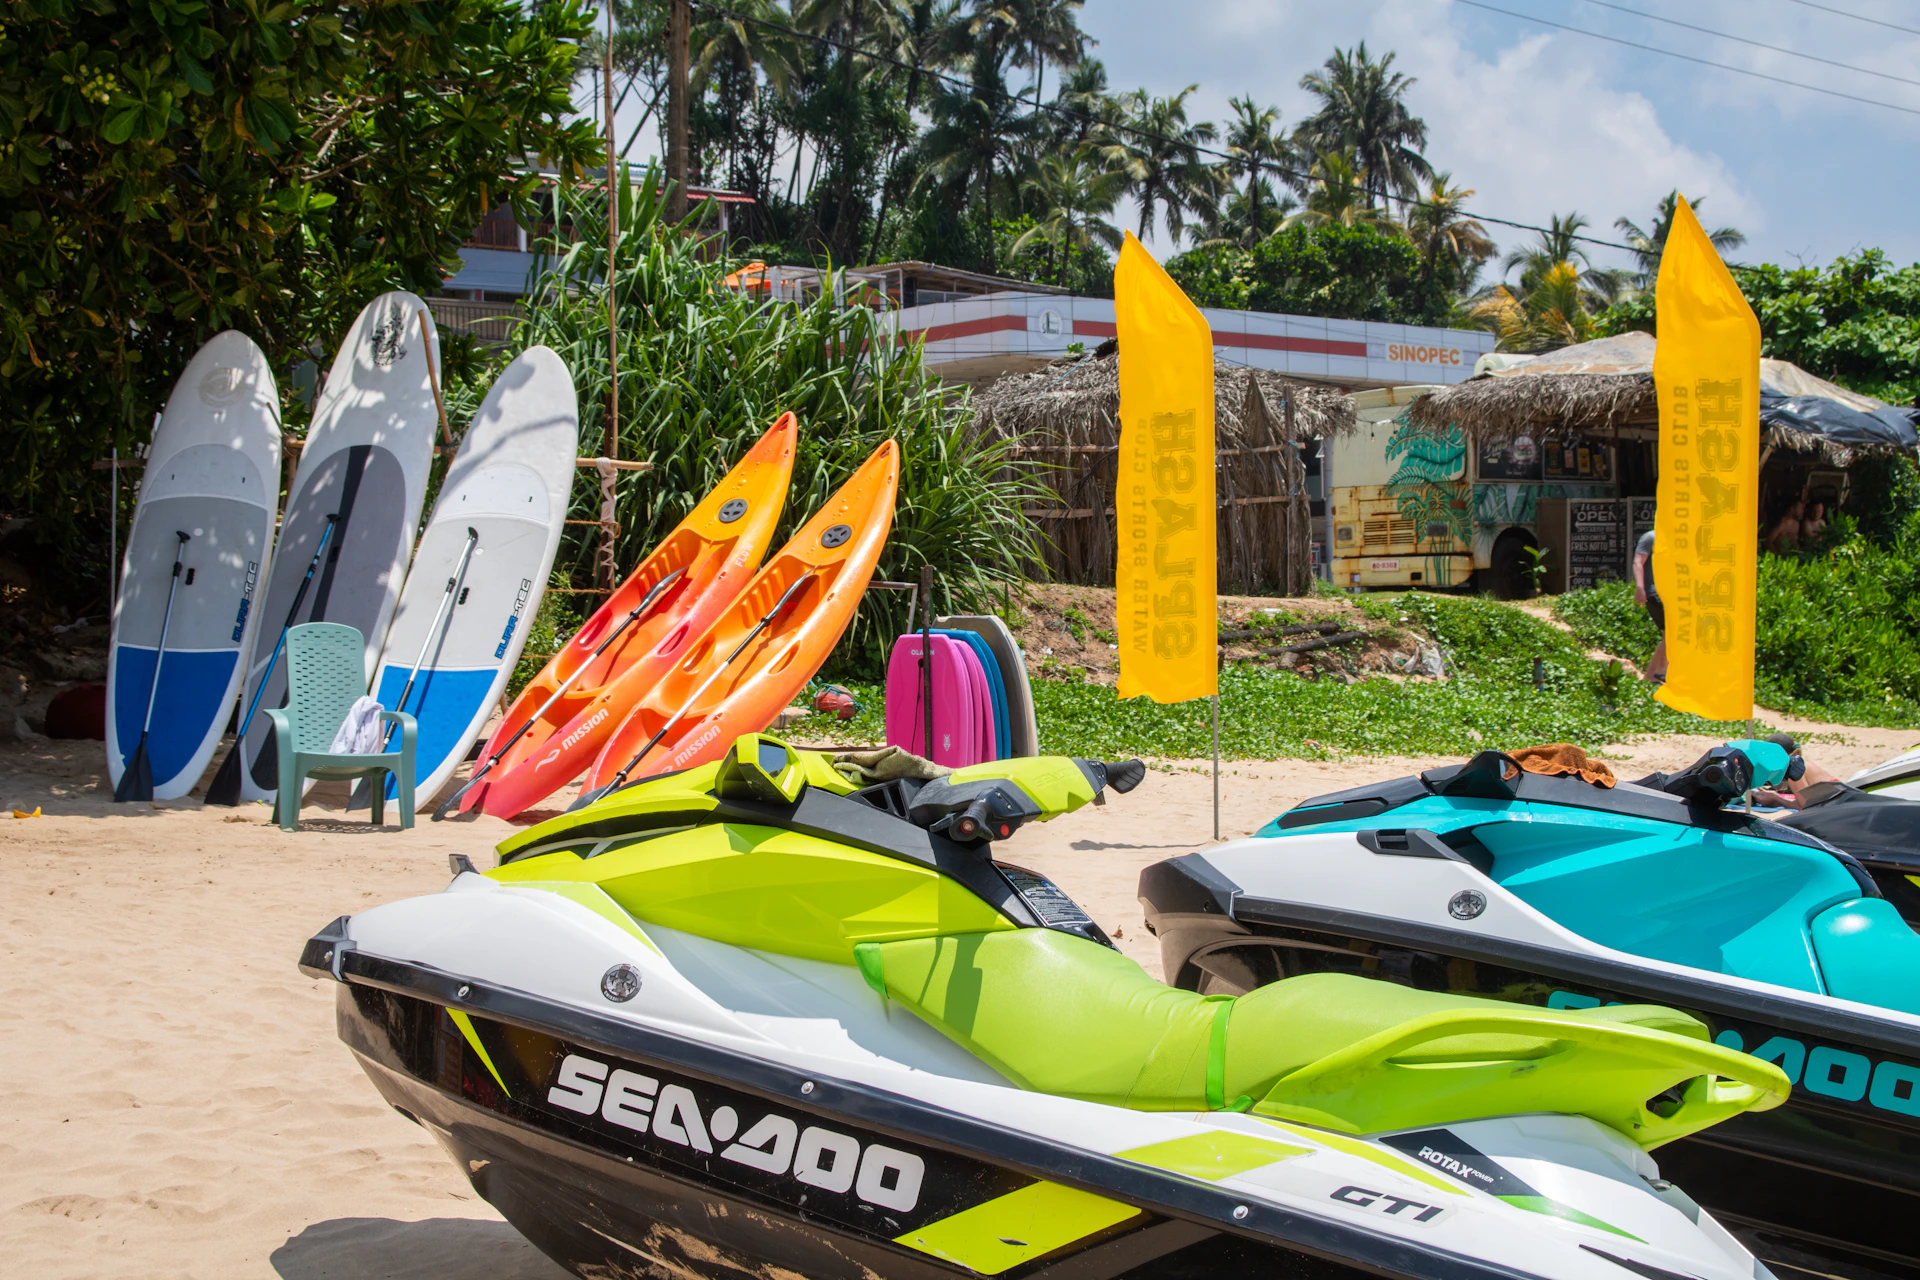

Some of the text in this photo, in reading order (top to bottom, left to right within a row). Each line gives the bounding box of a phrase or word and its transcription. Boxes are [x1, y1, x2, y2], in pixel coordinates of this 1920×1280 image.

[1388, 344, 1460, 365] SINOPEC
[1577, 511, 1617, 521] OPEN
[231, 560, 258, 643] DURA-TEC
[494, 578, 531, 660] DURA-TEC
[561, 708, 609, 750] mission
[674, 725, 721, 767] mission
[1418, 1145, 1494, 1183] ROTAX POWER
[1330, 1185, 1444, 1223] GTI
